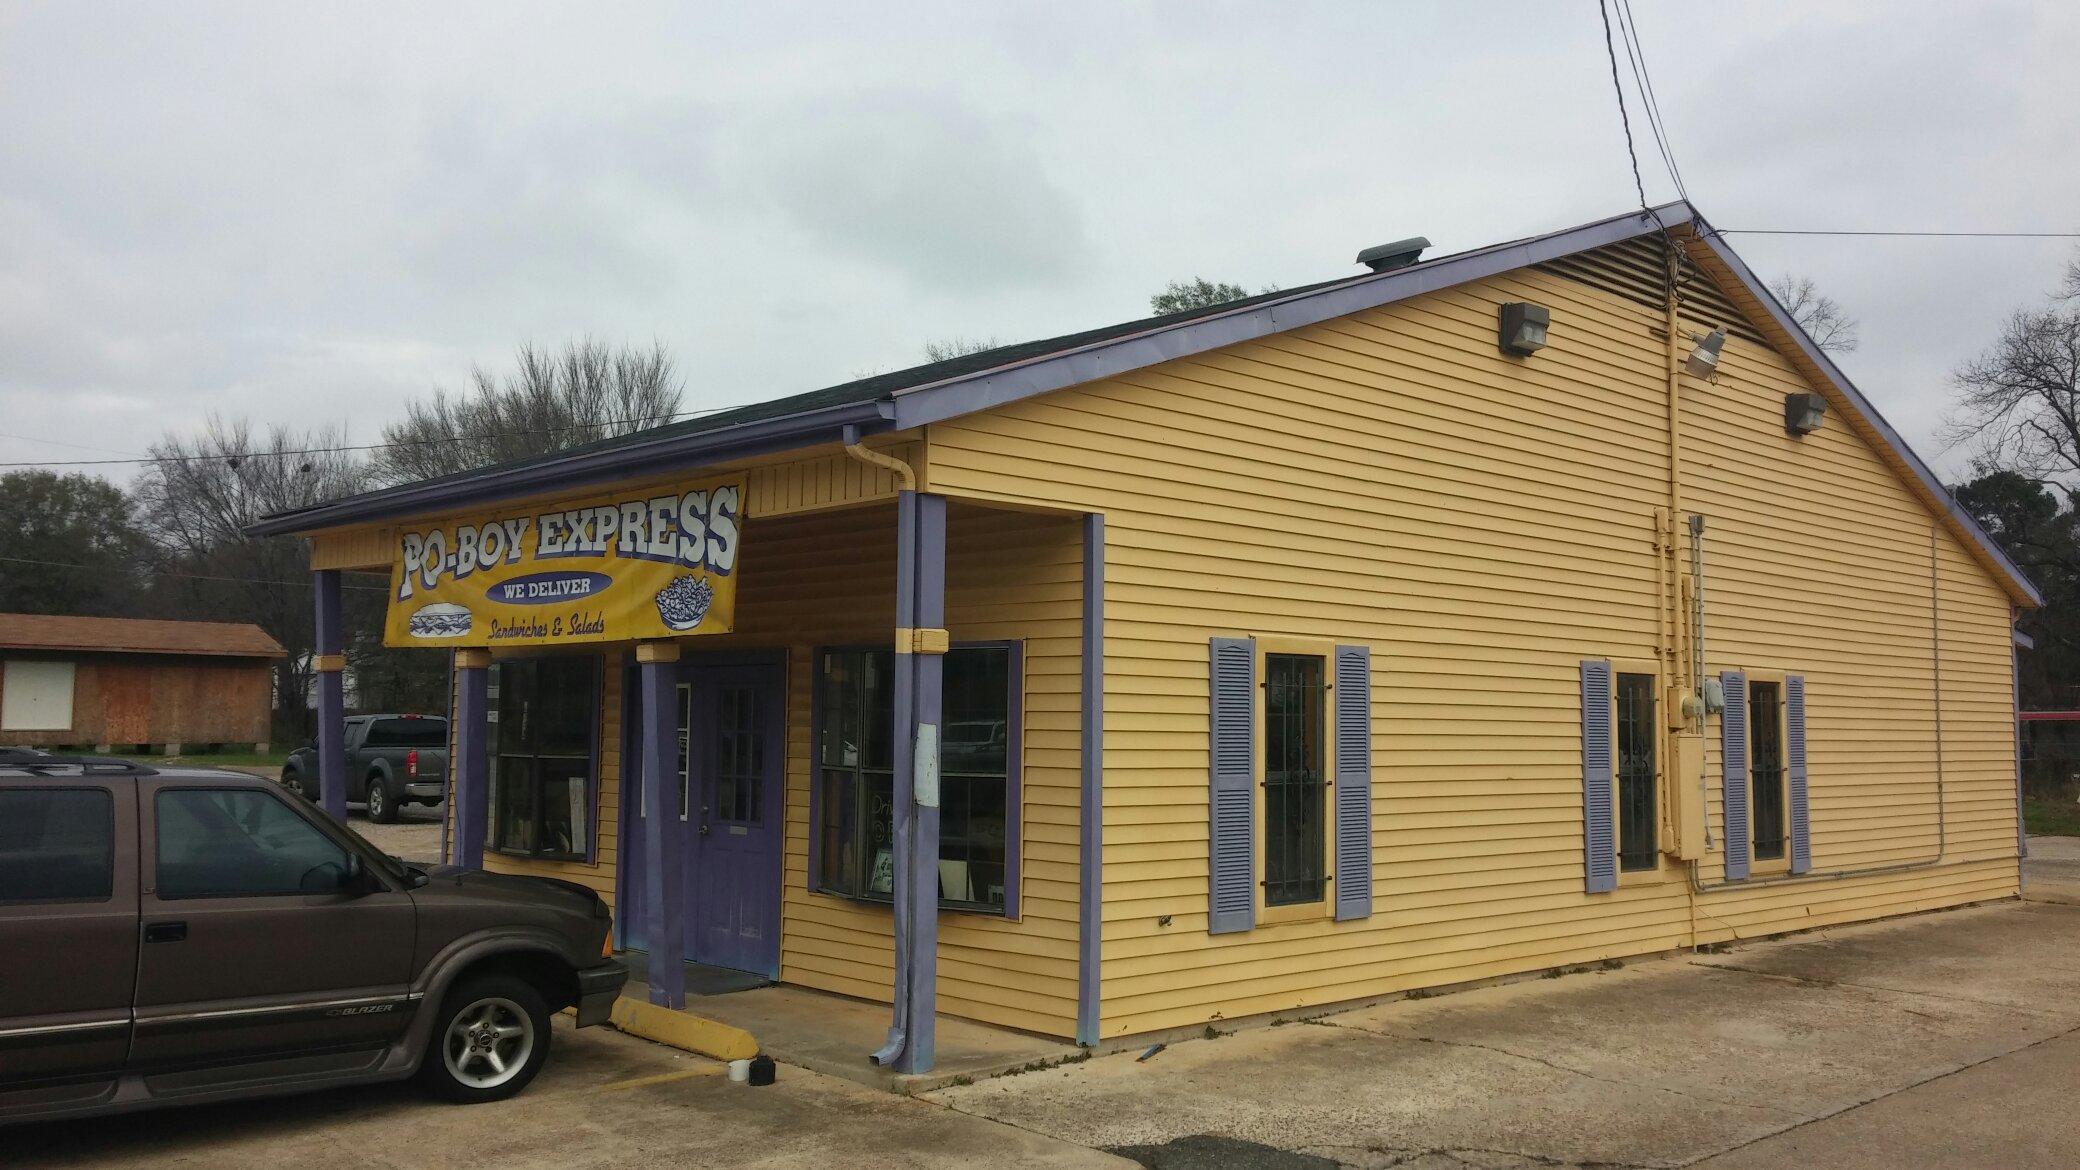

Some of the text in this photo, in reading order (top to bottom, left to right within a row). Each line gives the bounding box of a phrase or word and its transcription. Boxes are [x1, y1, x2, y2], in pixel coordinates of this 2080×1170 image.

[398, 485, 739, 602] PO-BOY EXPRESS
[503, 578, 591, 599] WE DELIVER
[488, 610, 605, 639] Sandwiches & Salads
[341, 1004, 394, 1016] BLAZER
